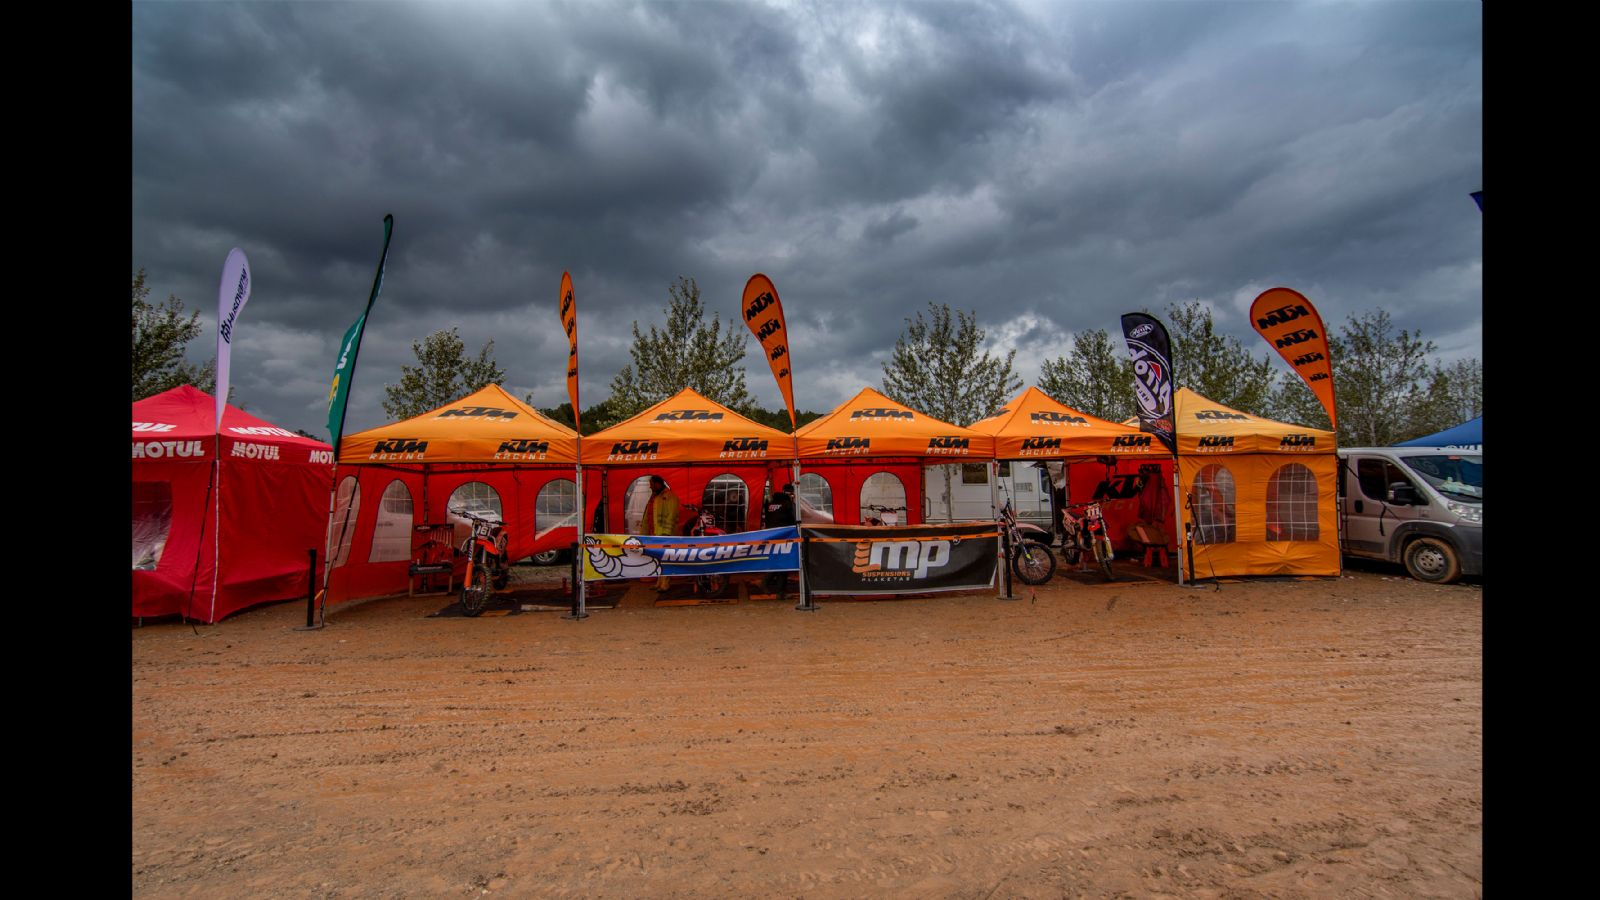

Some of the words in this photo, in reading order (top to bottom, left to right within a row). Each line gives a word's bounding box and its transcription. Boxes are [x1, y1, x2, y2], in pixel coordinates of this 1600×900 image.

[438, 406, 519, 419] KTM
[655, 409, 724, 421] KTM
[850, 408, 914, 419] KTM
[1030, 411, 1088, 423] KTM
[1195, 410, 1250, 420] KTM
[373, 438, 429, 454] KTM
[497, 438, 550, 454] KTM
[722, 437, 768, 452] KTM
[826, 436, 870, 450] KTM
[928, 435, 970, 449] KTM
[1021, 436, 1062, 450] KTM
[1112, 434, 1152, 447] KTM
[1198, 434, 1235, 447] KTM
[1280, 433, 1315, 447] KTM
[132, 440, 205, 459] MOTUL
[230, 441, 280, 461] MOTUL
[610, 439, 659, 455] KTM
[368, 453, 424, 461] RACING
[493, 453, 546, 461] RACING
[607, 454, 657, 462] RACING
[719, 451, 767, 459] RACING
[661, 541, 793, 562] MICHELIN
